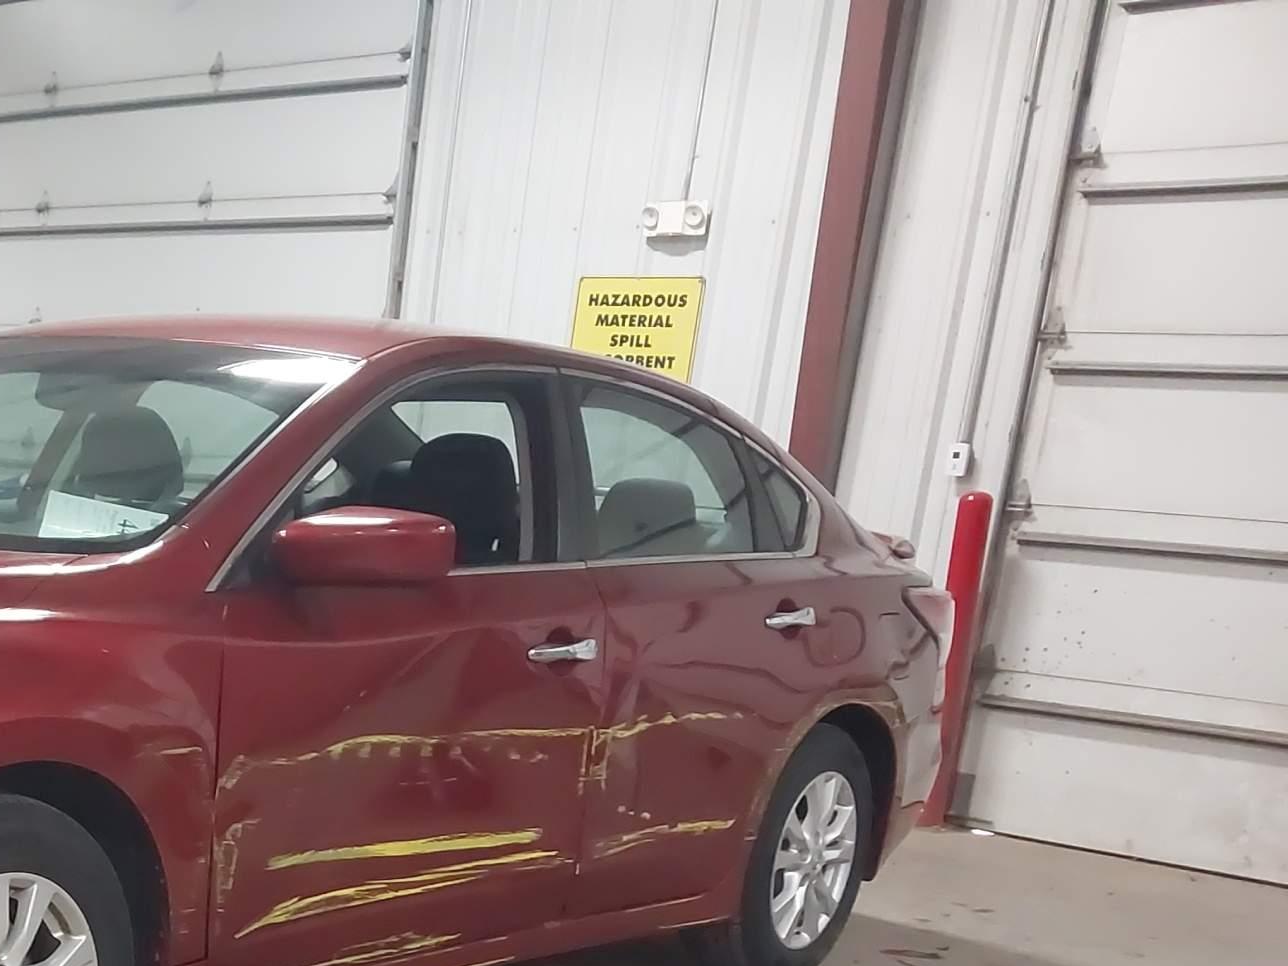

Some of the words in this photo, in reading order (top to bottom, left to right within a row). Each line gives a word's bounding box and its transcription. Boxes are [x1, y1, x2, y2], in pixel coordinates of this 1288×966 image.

[588, 293, 689, 308] HAZARDOUS
[595, 314, 673, 328] MATERIAL
[609, 334, 652, 348] SPILL
[605, 354, 676, 369] RBENT
